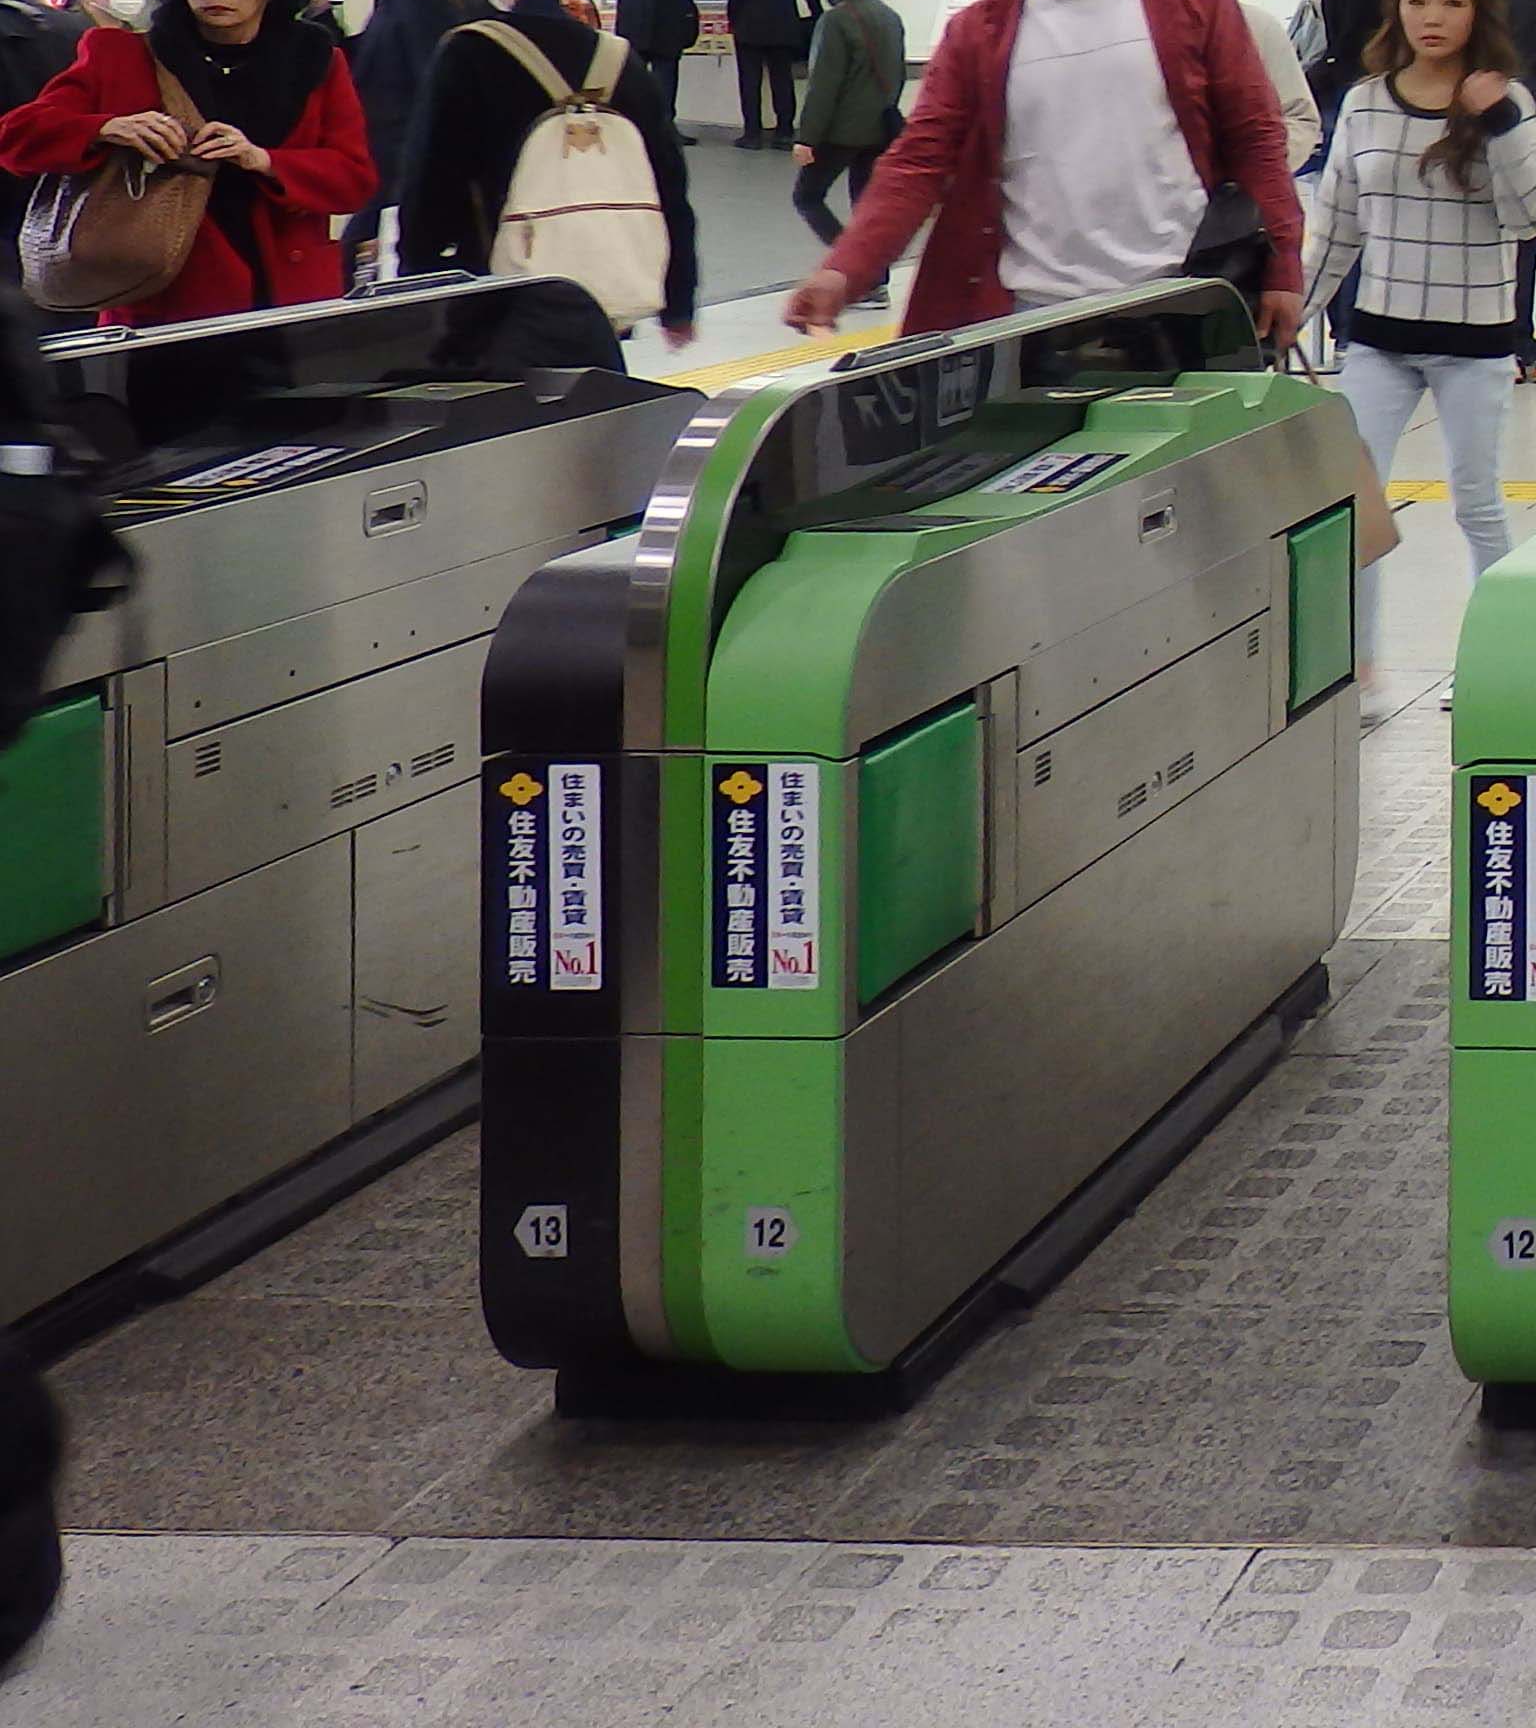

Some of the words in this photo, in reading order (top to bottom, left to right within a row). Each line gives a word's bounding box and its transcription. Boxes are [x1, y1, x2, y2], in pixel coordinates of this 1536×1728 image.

[508, 811, 536, 984] 住友不動産販売
[727, 809, 755, 983] 住友不動産販売
[1484, 821, 1513, 995] 住友不動産販売
[555, 941, 598, 975] No.1
[772, 940, 816, 975] No.1
[530, 1216, 561, 1246] 13
[753, 1218, 785, 1248] 12
[1502, 1229, 1535, 1259] 12
